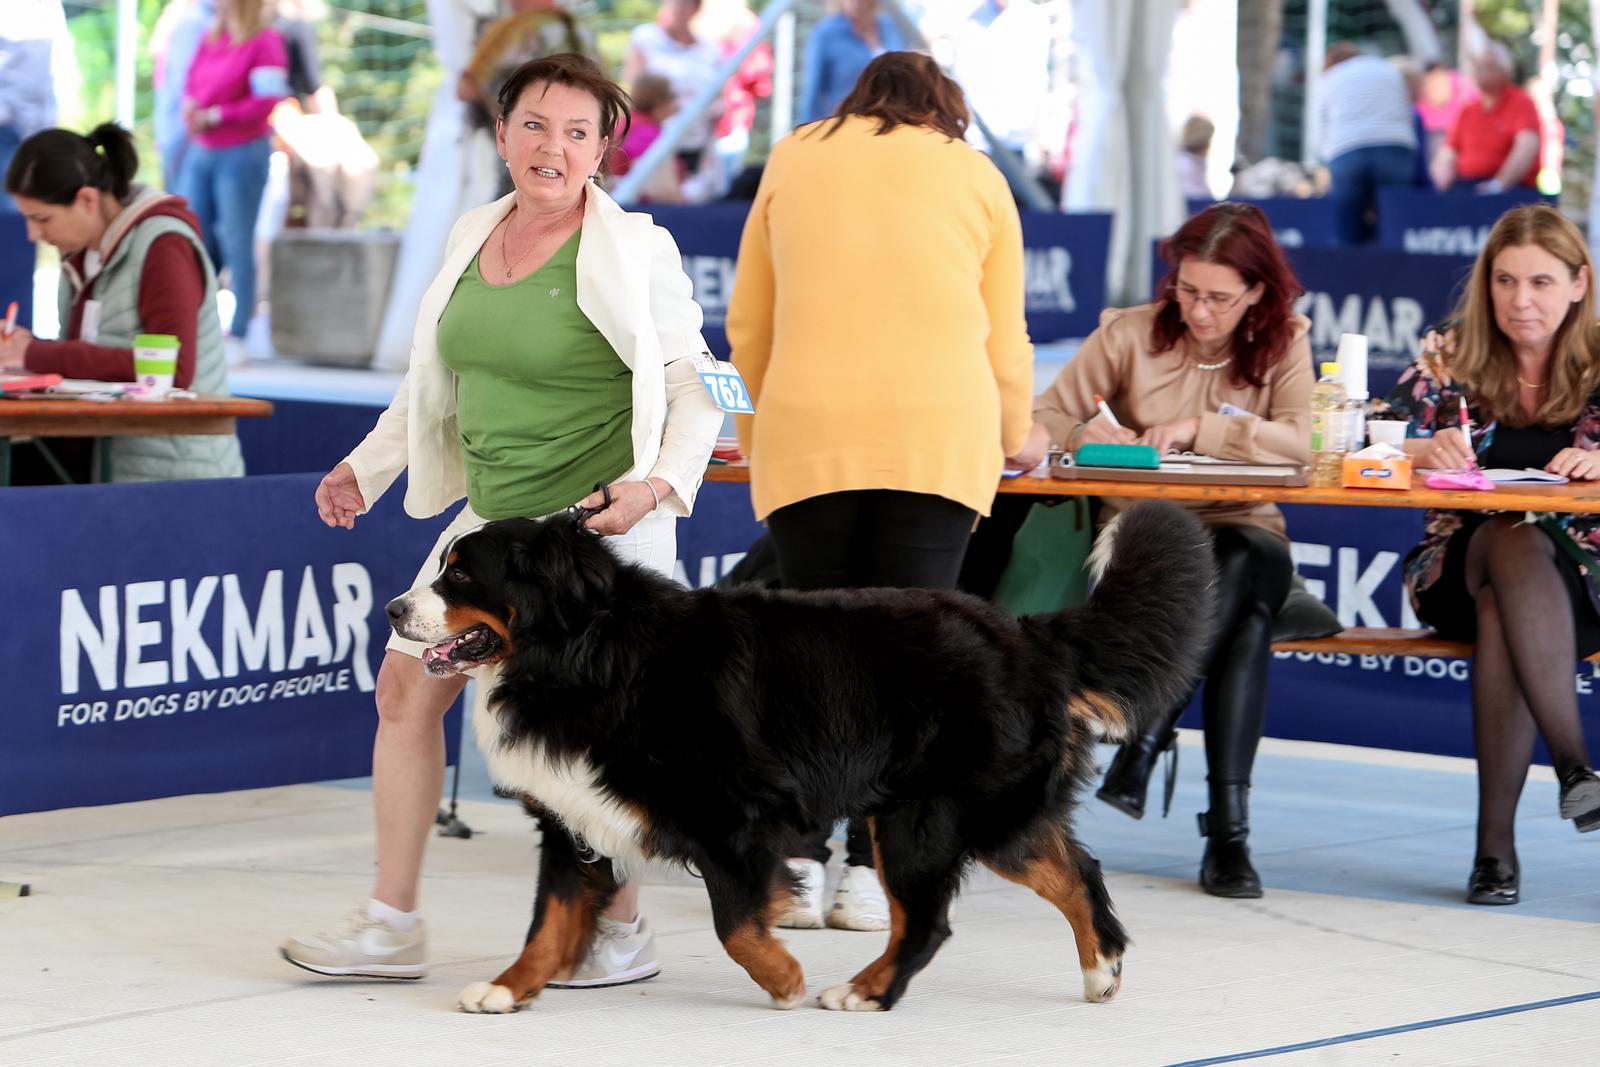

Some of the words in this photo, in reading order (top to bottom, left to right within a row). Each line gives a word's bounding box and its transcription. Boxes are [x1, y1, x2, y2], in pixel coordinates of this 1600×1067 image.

[703, 375, 749, 409] 762
[60, 562, 375, 694] NEKMAR
[1360, 654, 1395, 672] BY
[1404, 656, 1469, 681] DOG
[58, 701, 107, 727] FOR
[114, 693, 180, 722] DOGS
[184, 689, 217, 713] BY
[217, 682, 267, 708] DOG
[270, 669, 350, 699] PEOPLE
